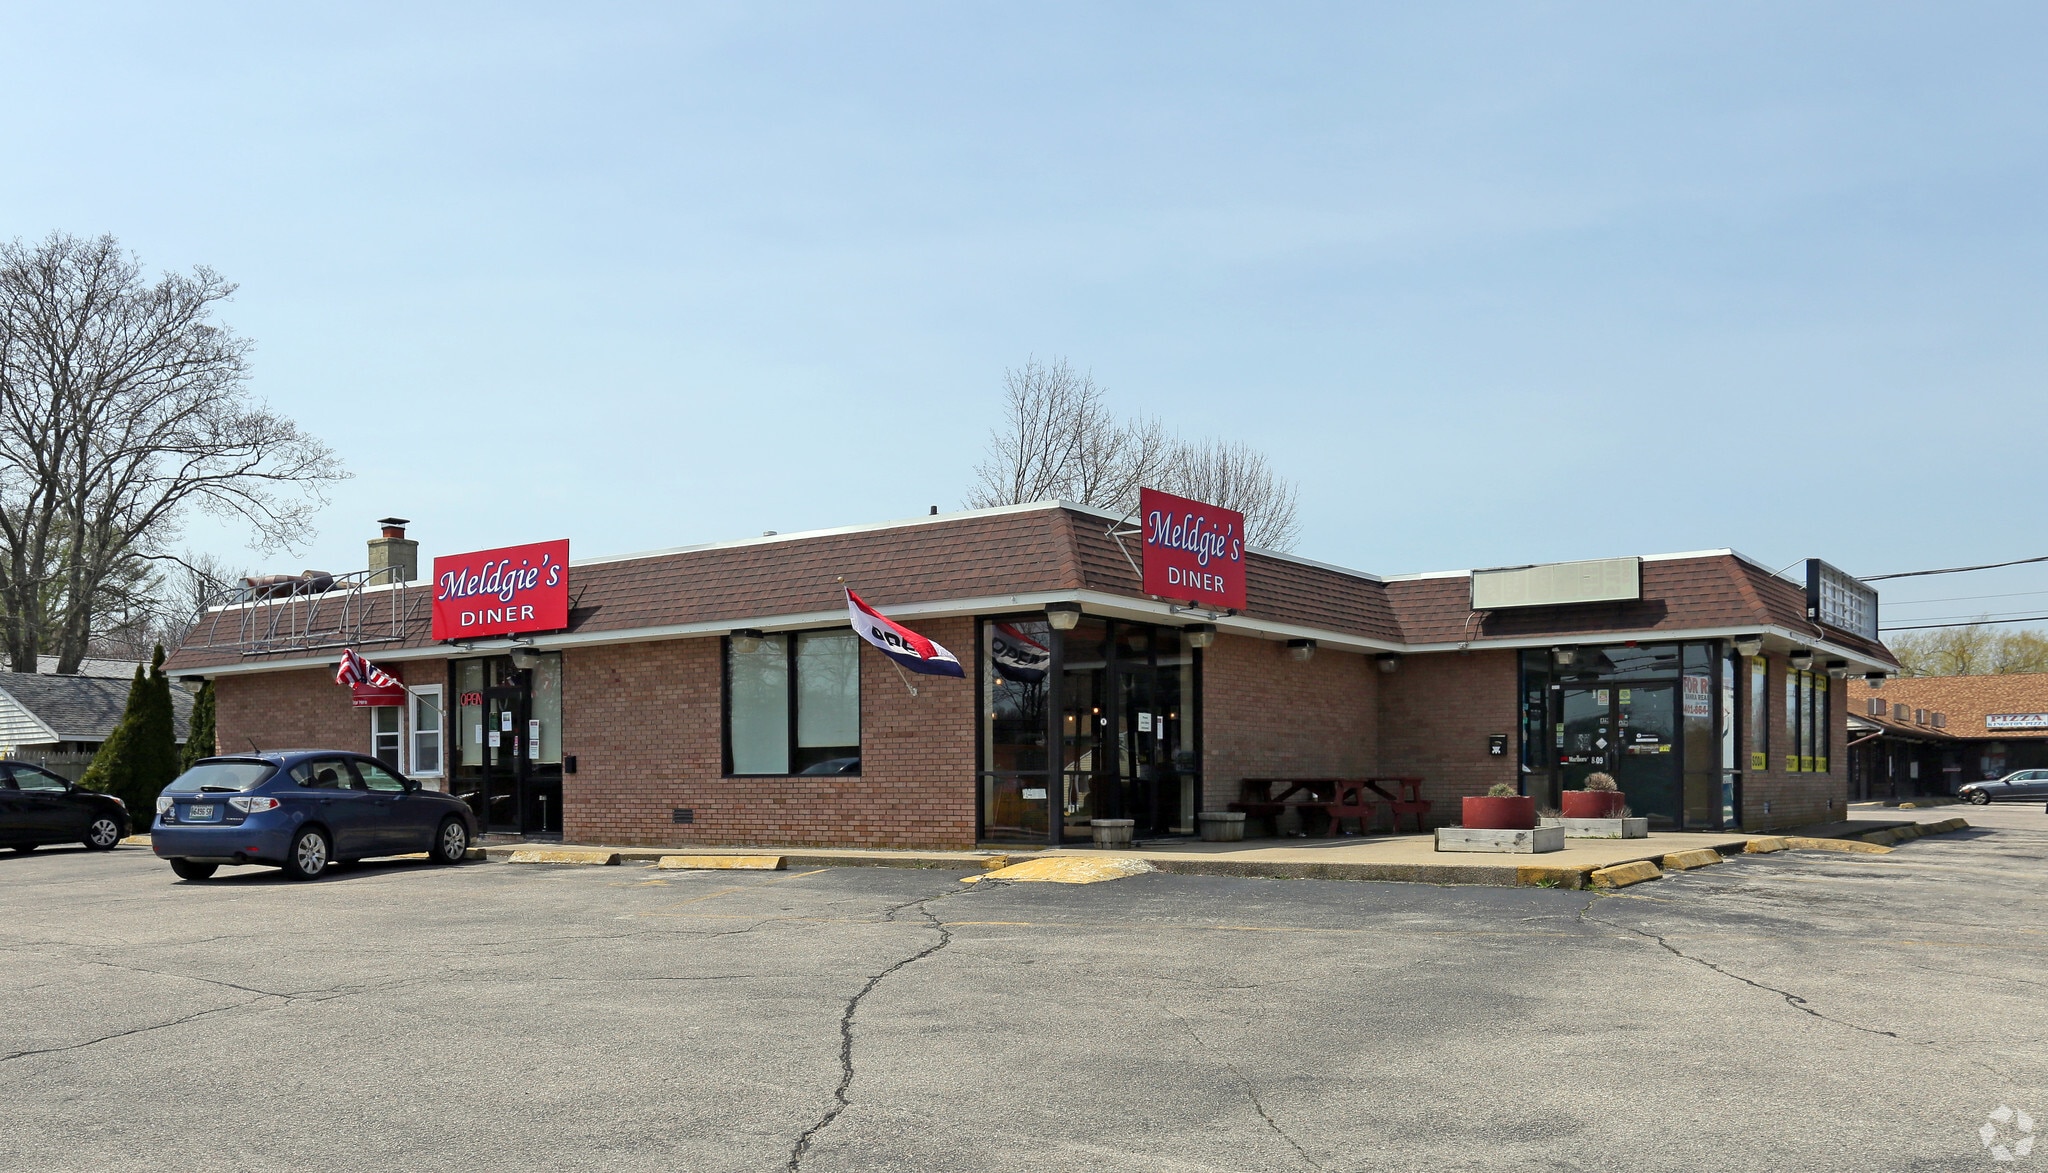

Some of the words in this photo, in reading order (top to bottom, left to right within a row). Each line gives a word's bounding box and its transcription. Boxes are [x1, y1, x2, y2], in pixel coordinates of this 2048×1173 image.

[1147, 510, 1241, 567] Meldgie's
[437, 553, 561, 603] Meldgie's
[1168, 566, 1225, 593] DINER
[460, 604, 535, 627] DINER
[993, 637, 1050, 665] OPEN
[1683, 677, 1698, 693] FOR
[460, 692, 482, 706] OPEN
